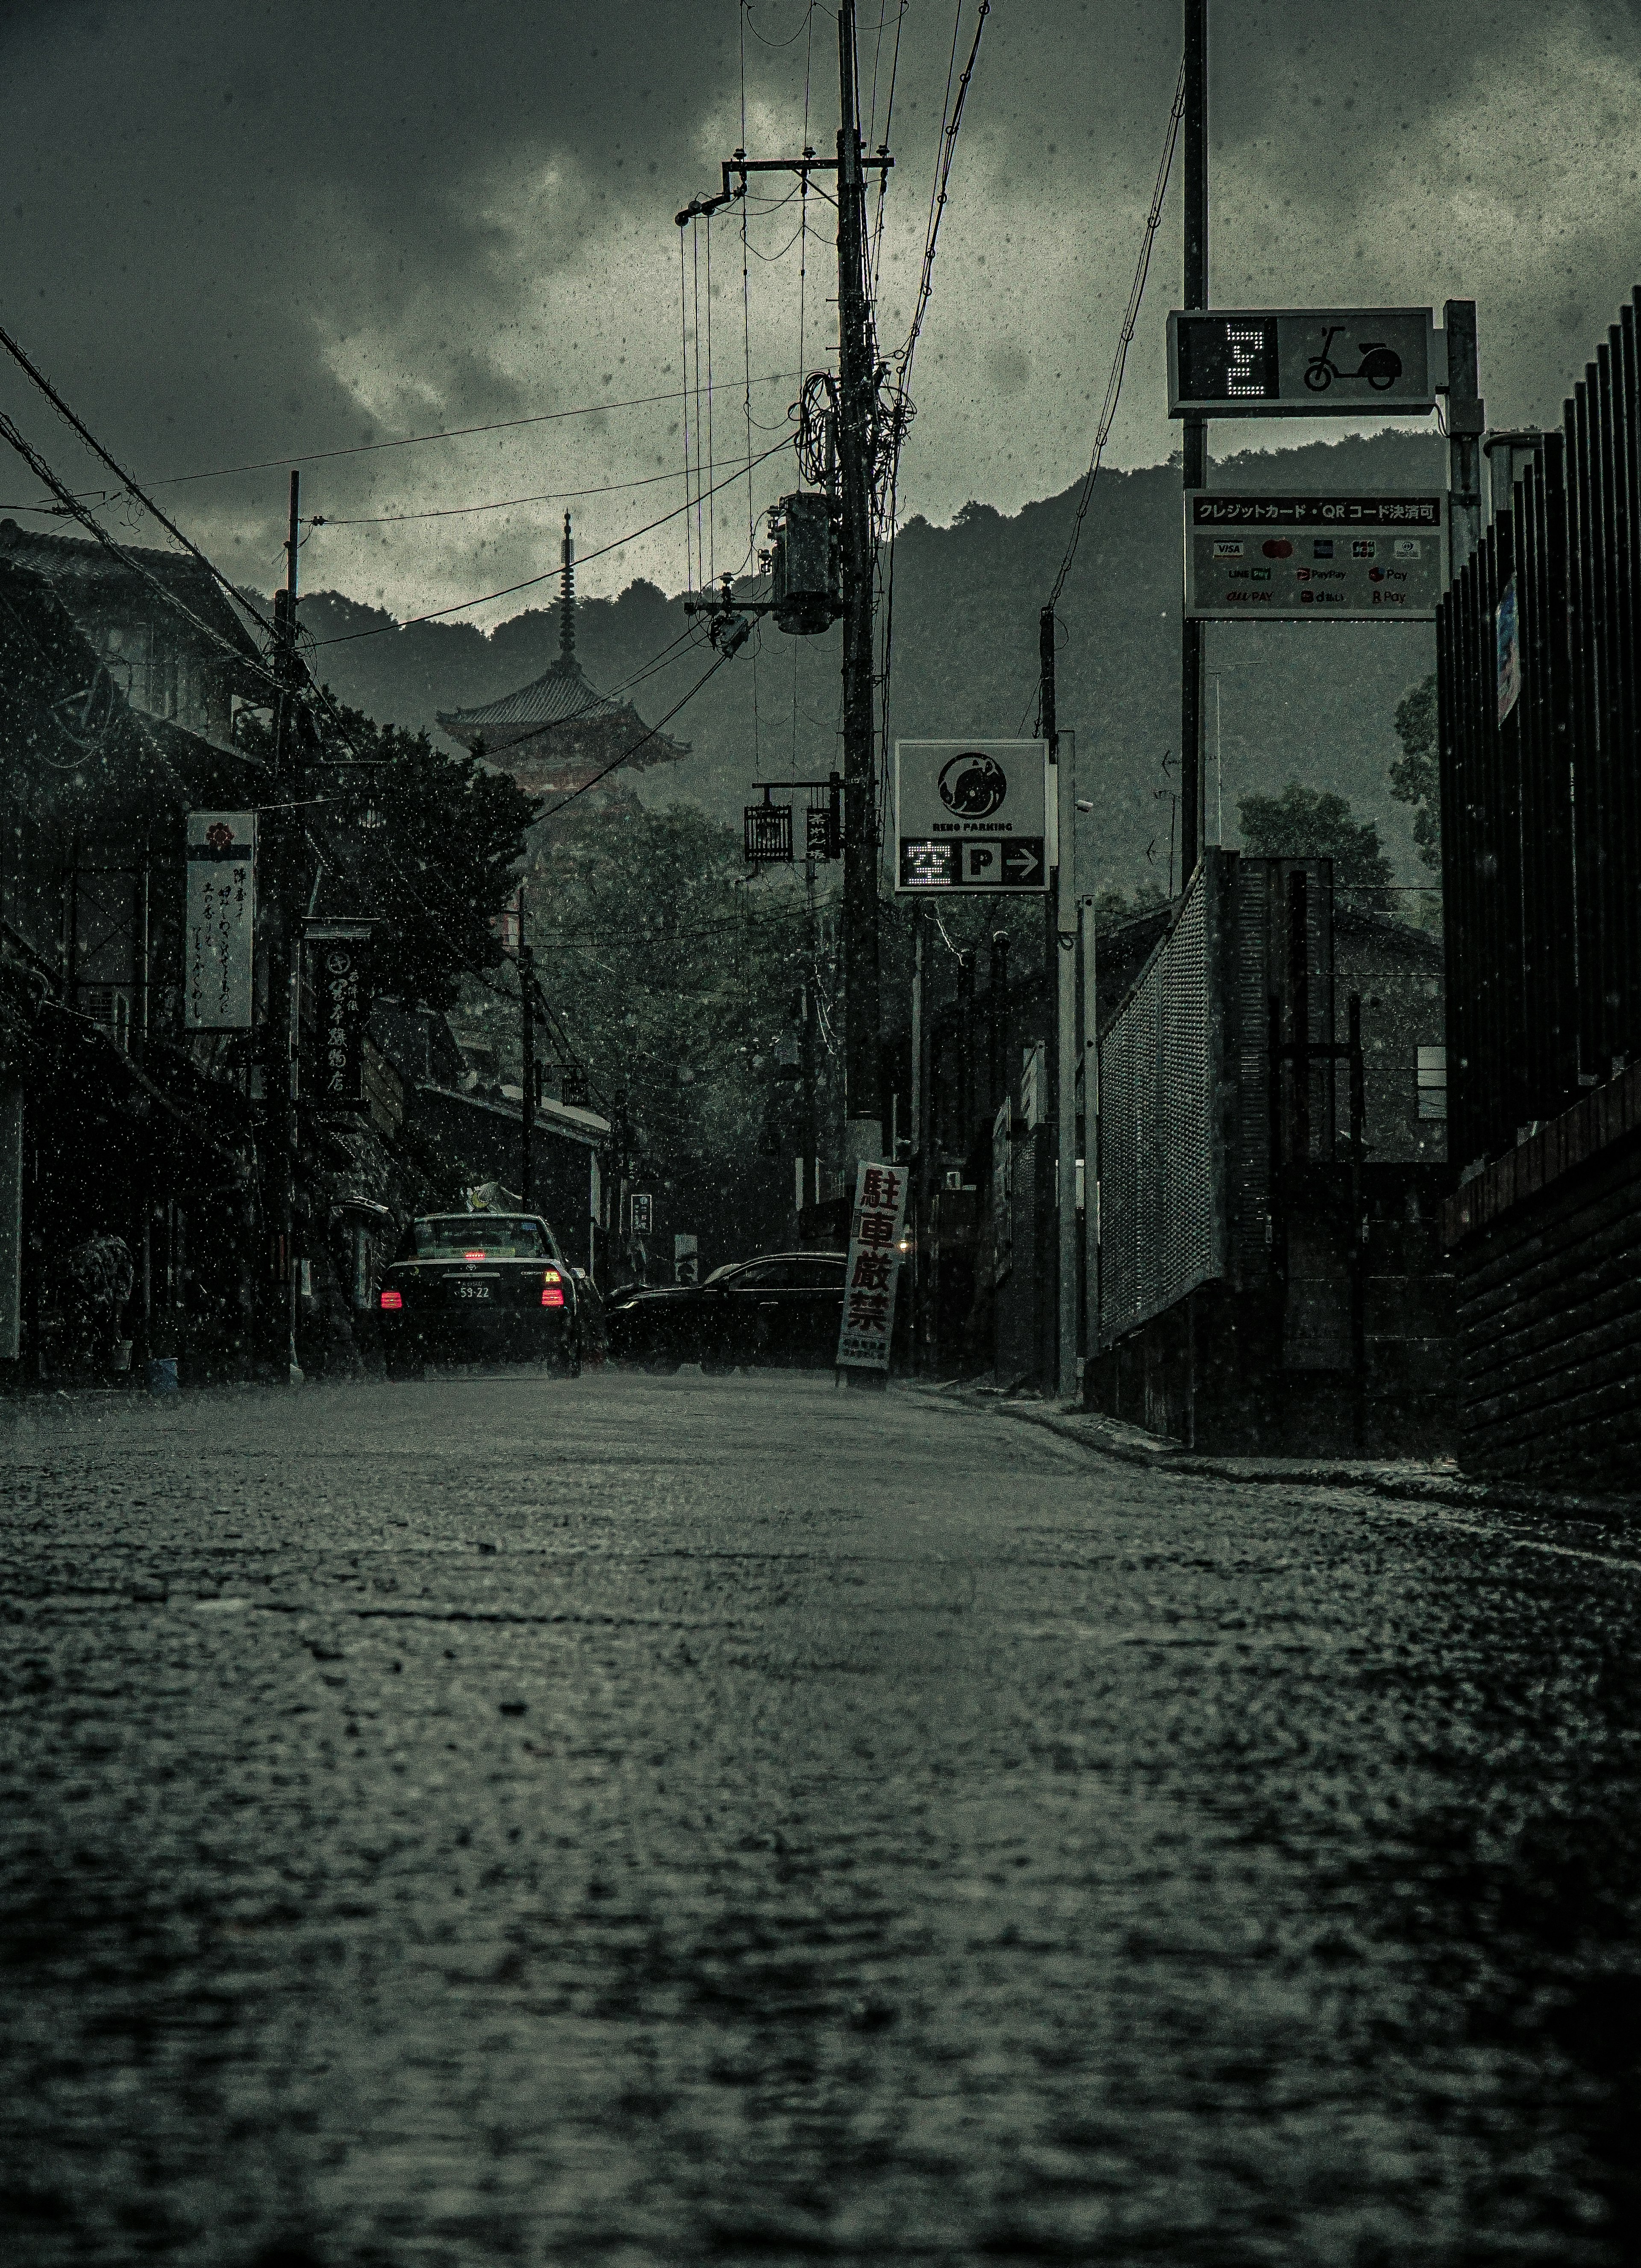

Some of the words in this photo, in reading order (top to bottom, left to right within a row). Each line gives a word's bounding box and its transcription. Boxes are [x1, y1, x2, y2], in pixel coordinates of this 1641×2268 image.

[1218, 545, 1240, 553] VISA
[1229, 570, 1250, 578] LINE
[1312, 570, 1347, 580] PayPay
[1387, 569, 1407, 582] Pay
[1253, 591, 1274, 601] PAY
[1384, 591, 1407, 604] Pay
[963, 823, 1013, 831] PARKING
[908, 841, 950, 884] 空
[970, 849, 993, 875] P
[847, 1169, 900, 1332] 駐車厳禁
[461, 1287, 489, 1297] 59-22
